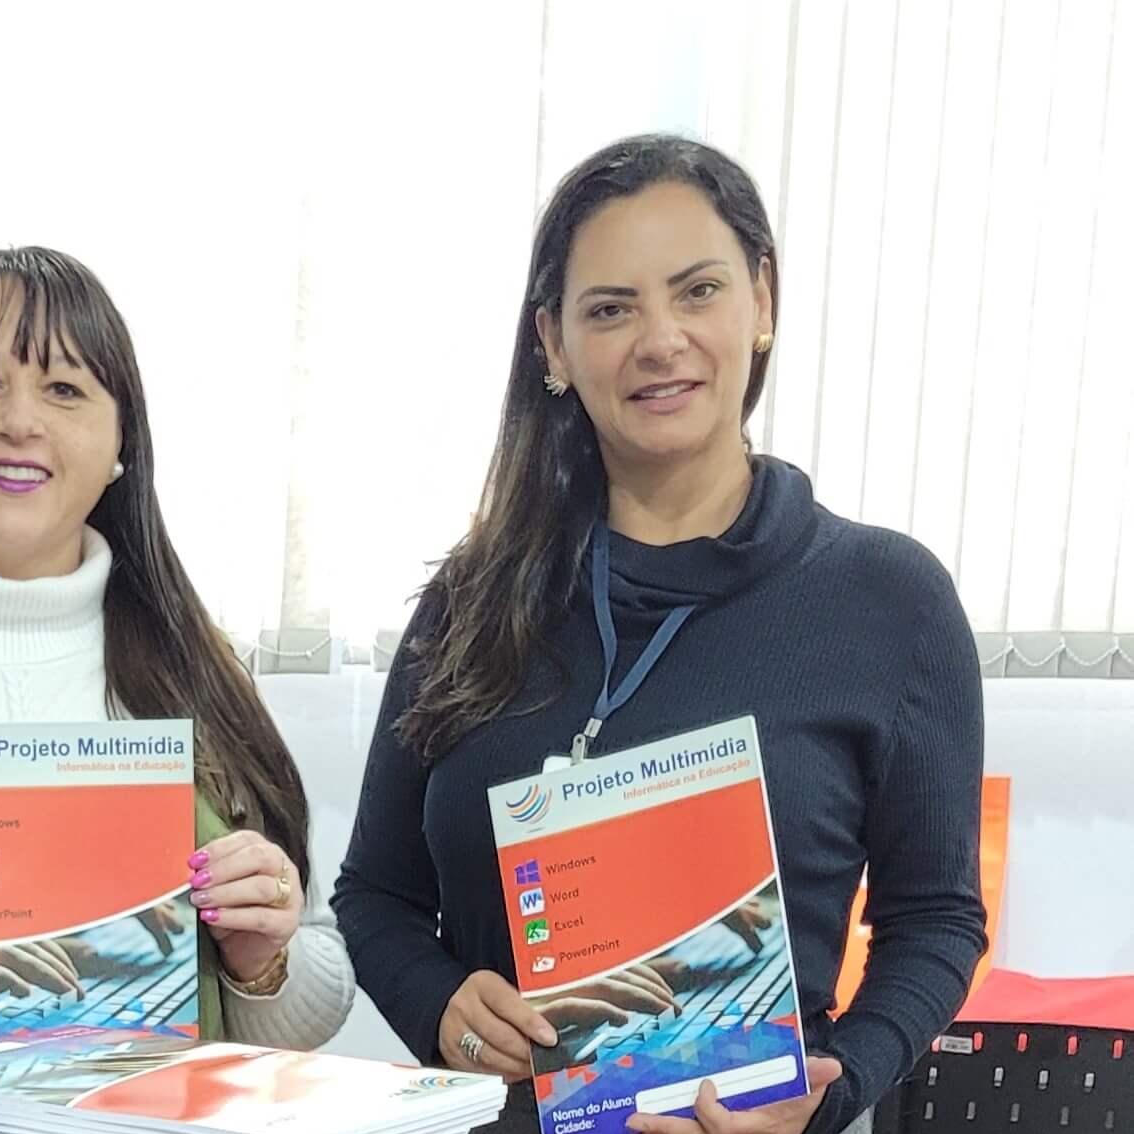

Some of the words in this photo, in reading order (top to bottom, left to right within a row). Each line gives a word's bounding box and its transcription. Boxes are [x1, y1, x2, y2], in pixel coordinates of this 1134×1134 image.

[77, 736, 185, 756] Multimídia
[562, 770, 634, 801] Projeto
[641, 737, 747, 780] Multimídia
[623, 779, 681, 800] Informática
[683, 773, 696, 784] na
[698, 758, 751, 779] Educação
[545, 856, 596, 875] Windows
[550, 888, 579, 904] Word
[554, 916, 584, 931] Excel
[559, 939, 620, 963] PowerPoint
[552, 1107, 585, 1122] Nome
[586, 1103, 601, 1116] do
[601, 1096, 635, 1112] Aluno:
